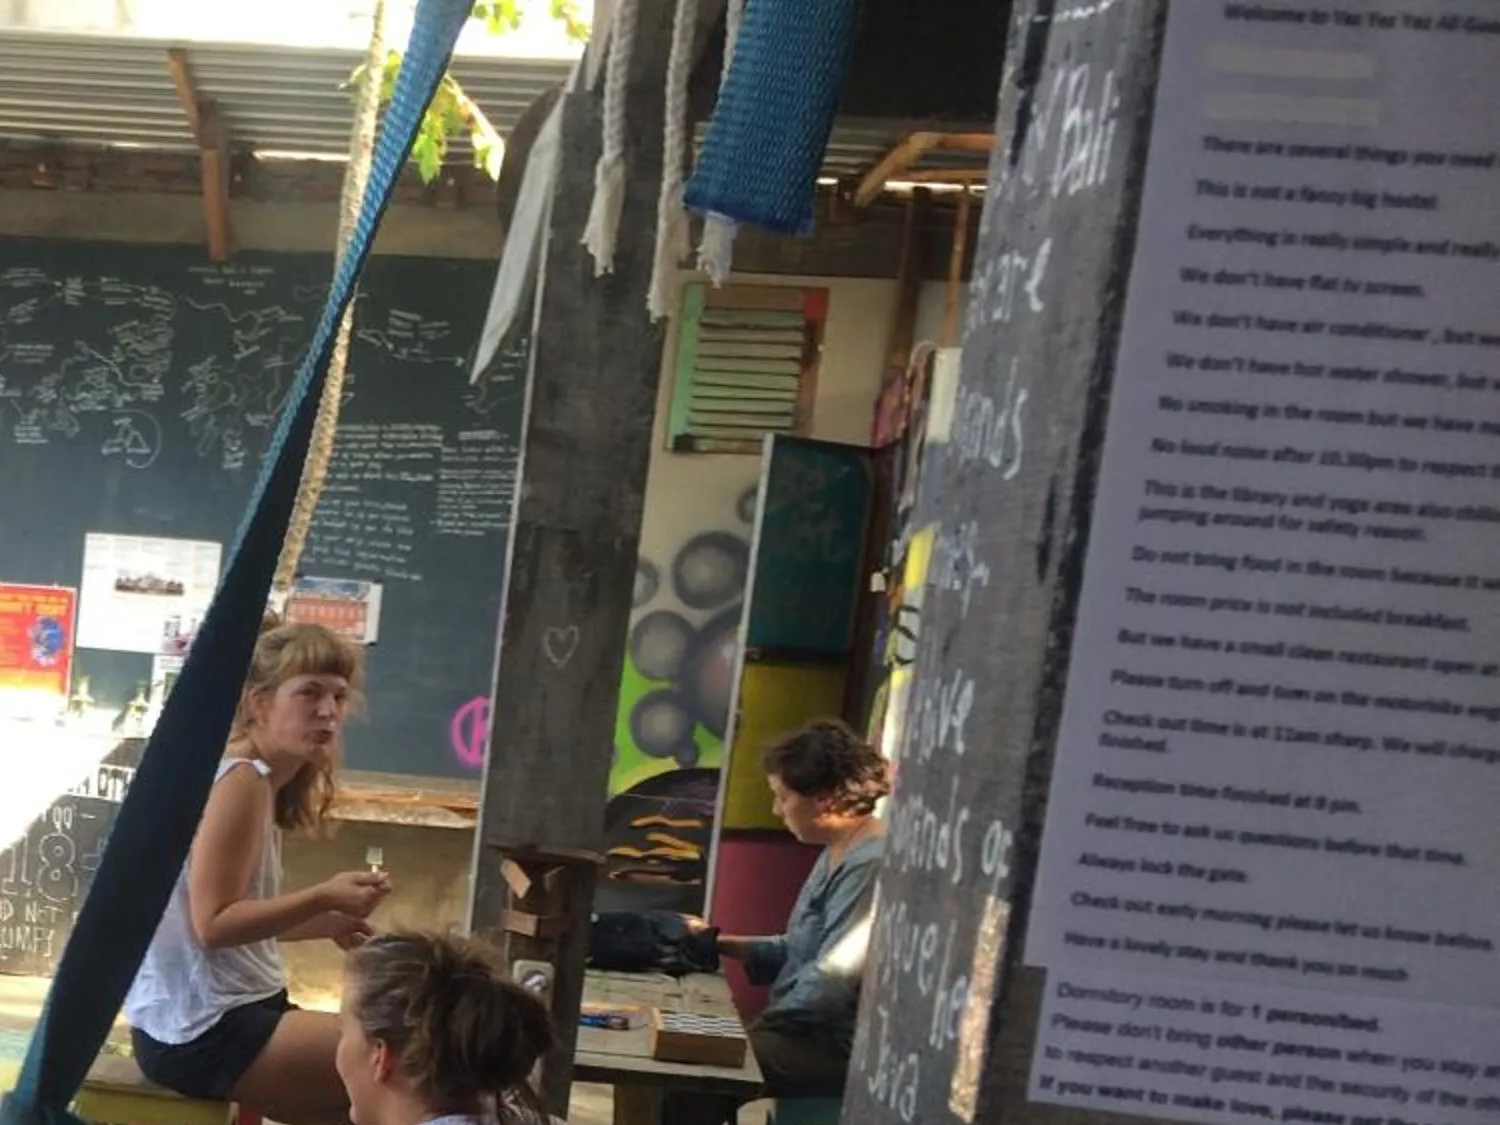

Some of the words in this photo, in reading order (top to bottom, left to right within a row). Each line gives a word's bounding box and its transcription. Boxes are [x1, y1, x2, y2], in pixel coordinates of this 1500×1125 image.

[1056, 981, 1144, 1010] Dormitory
[1148, 994, 1196, 1011] room
[1050, 1013, 1113, 1036] Please
[1116, 1022, 1163, 1041] don't
[1165, 1027, 1213, 1051] bring
[1214, 1034, 1269, 1052] other
[1271, 1041, 1342, 1060] person
[1439, 1059, 1479, 1080] stay
[1066, 1050, 1134, 1069] respect
[1137, 1058, 1207, 1078] another
[1210, 1066, 1263, 1084] guest
[1339, 1081, 1411, 1105] security
[1096, 1085, 1146, 1102] want
[1171, 1094, 1226, 1112] make
[1280, 1106, 1346, 1125] please
